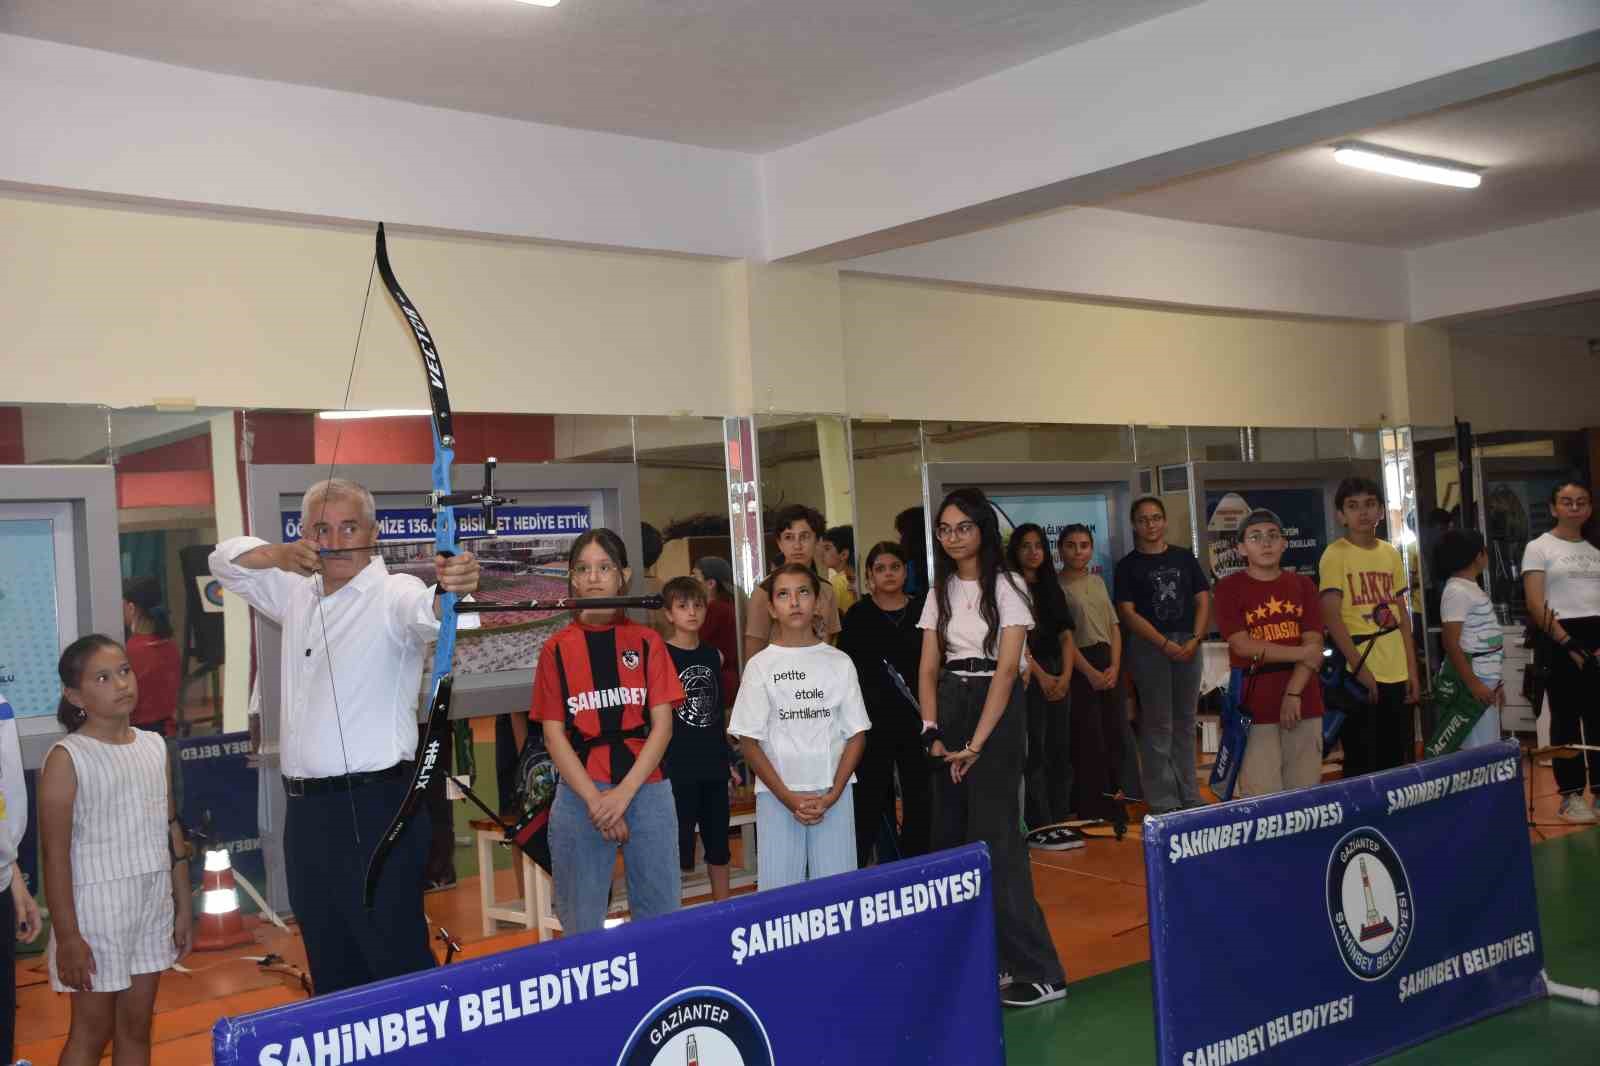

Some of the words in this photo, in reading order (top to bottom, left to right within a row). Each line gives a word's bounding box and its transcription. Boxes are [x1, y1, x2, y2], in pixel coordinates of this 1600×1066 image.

[459, 514, 511, 532] BİSİET
[514, 513, 554, 531] HEDİYE
[557, 512, 589, 529] ETTİK
[773, 670, 806, 684] petite
[415, 739, 441, 790] HELIX
[1169, 820, 1254, 864] ŞAHİNBEY
[1255, 801, 1343, 841] BELEDİYESİ
[731, 899, 854, 965] ŞAHİNBEY
[859, 868, 982, 927] BELEDİYESİ
[458, 951, 639, 1033] BELEDİYESİ
[1398, 955, 1461, 1003] ŞAHİNBEY
[1462, 930, 1535, 976] BELEDİYESİ
[650, 1004, 729, 1045] GAZİANTEP
[1265, 994, 1353, 1047] BELEDİYESİ
